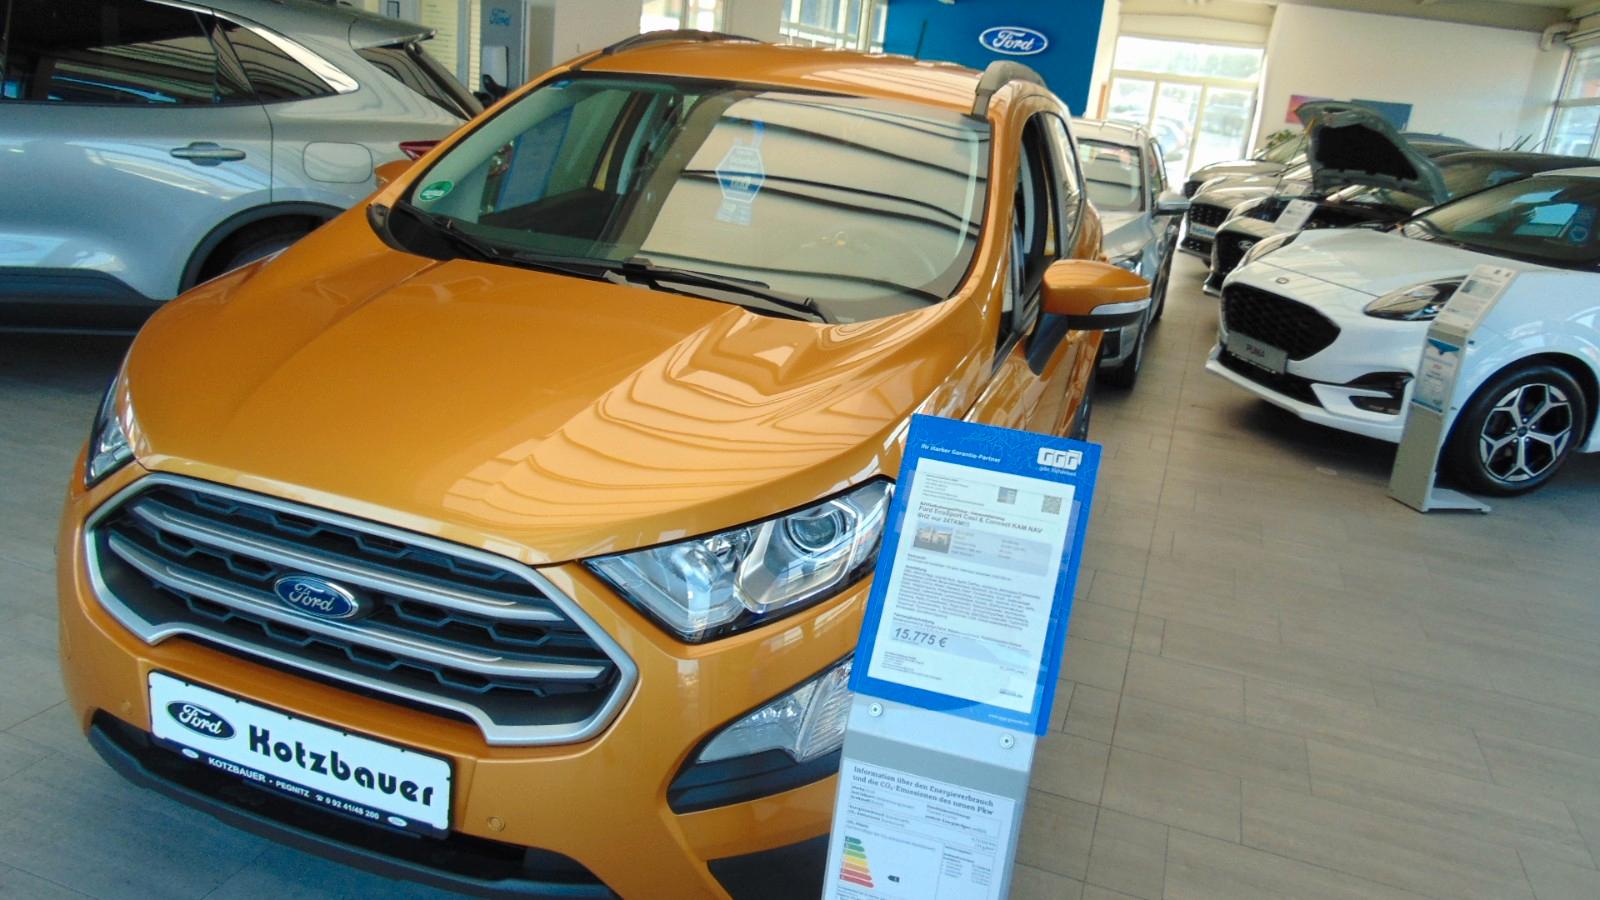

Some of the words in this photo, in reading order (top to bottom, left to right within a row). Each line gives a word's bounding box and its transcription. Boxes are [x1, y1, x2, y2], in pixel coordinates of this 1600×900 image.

[992, 29, 1035, 50] Ford
[288, 582, 336, 612] Ford
[894, 627, 936, 646] 15.775
[939, 636, 949, 649] €
[178, 704, 224, 736] Ford
[249, 723, 434, 807] Kotzbauer
[208, 757, 267, 784] KOTZBAUER
[275, 780, 311, 799] PEGNITZ
[853, 774, 867, 785] und
[867, 777, 879, 787] die
[939, 795, 952, 806] des
[953, 800, 976, 812] neuen
[977, 806, 994, 816] Pkw
[854, 765, 896, 782] Information
[897, 777, 913, 788] über
[914, 781, 928, 791] den
[929, 783, 994, 808] Energieverbrauch
